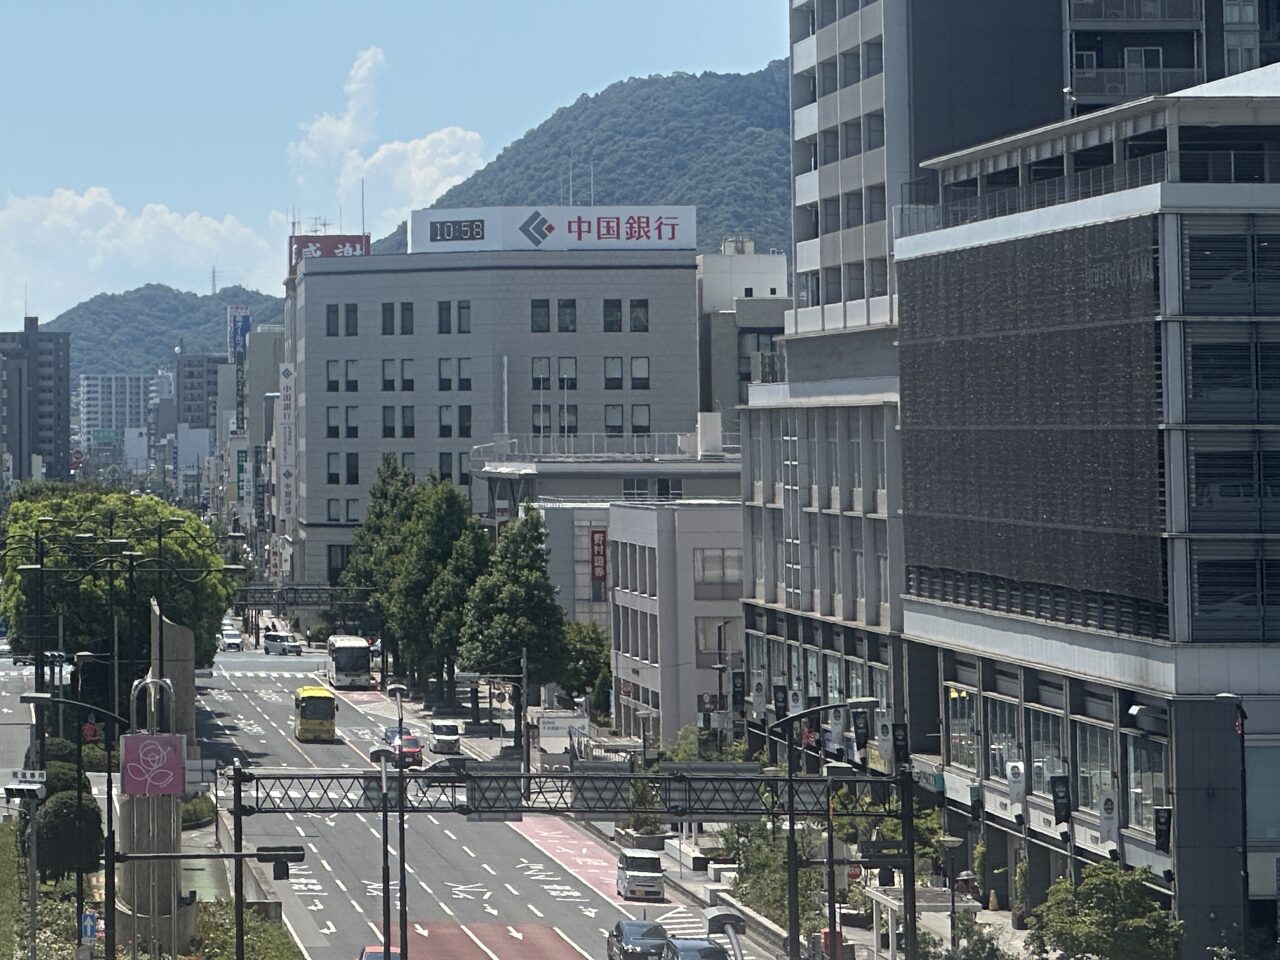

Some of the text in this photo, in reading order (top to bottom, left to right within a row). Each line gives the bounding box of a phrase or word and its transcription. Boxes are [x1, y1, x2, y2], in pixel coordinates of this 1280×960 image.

[434, 221, 483, 240] 10:58
[567, 215, 679, 242] 中国銀行
